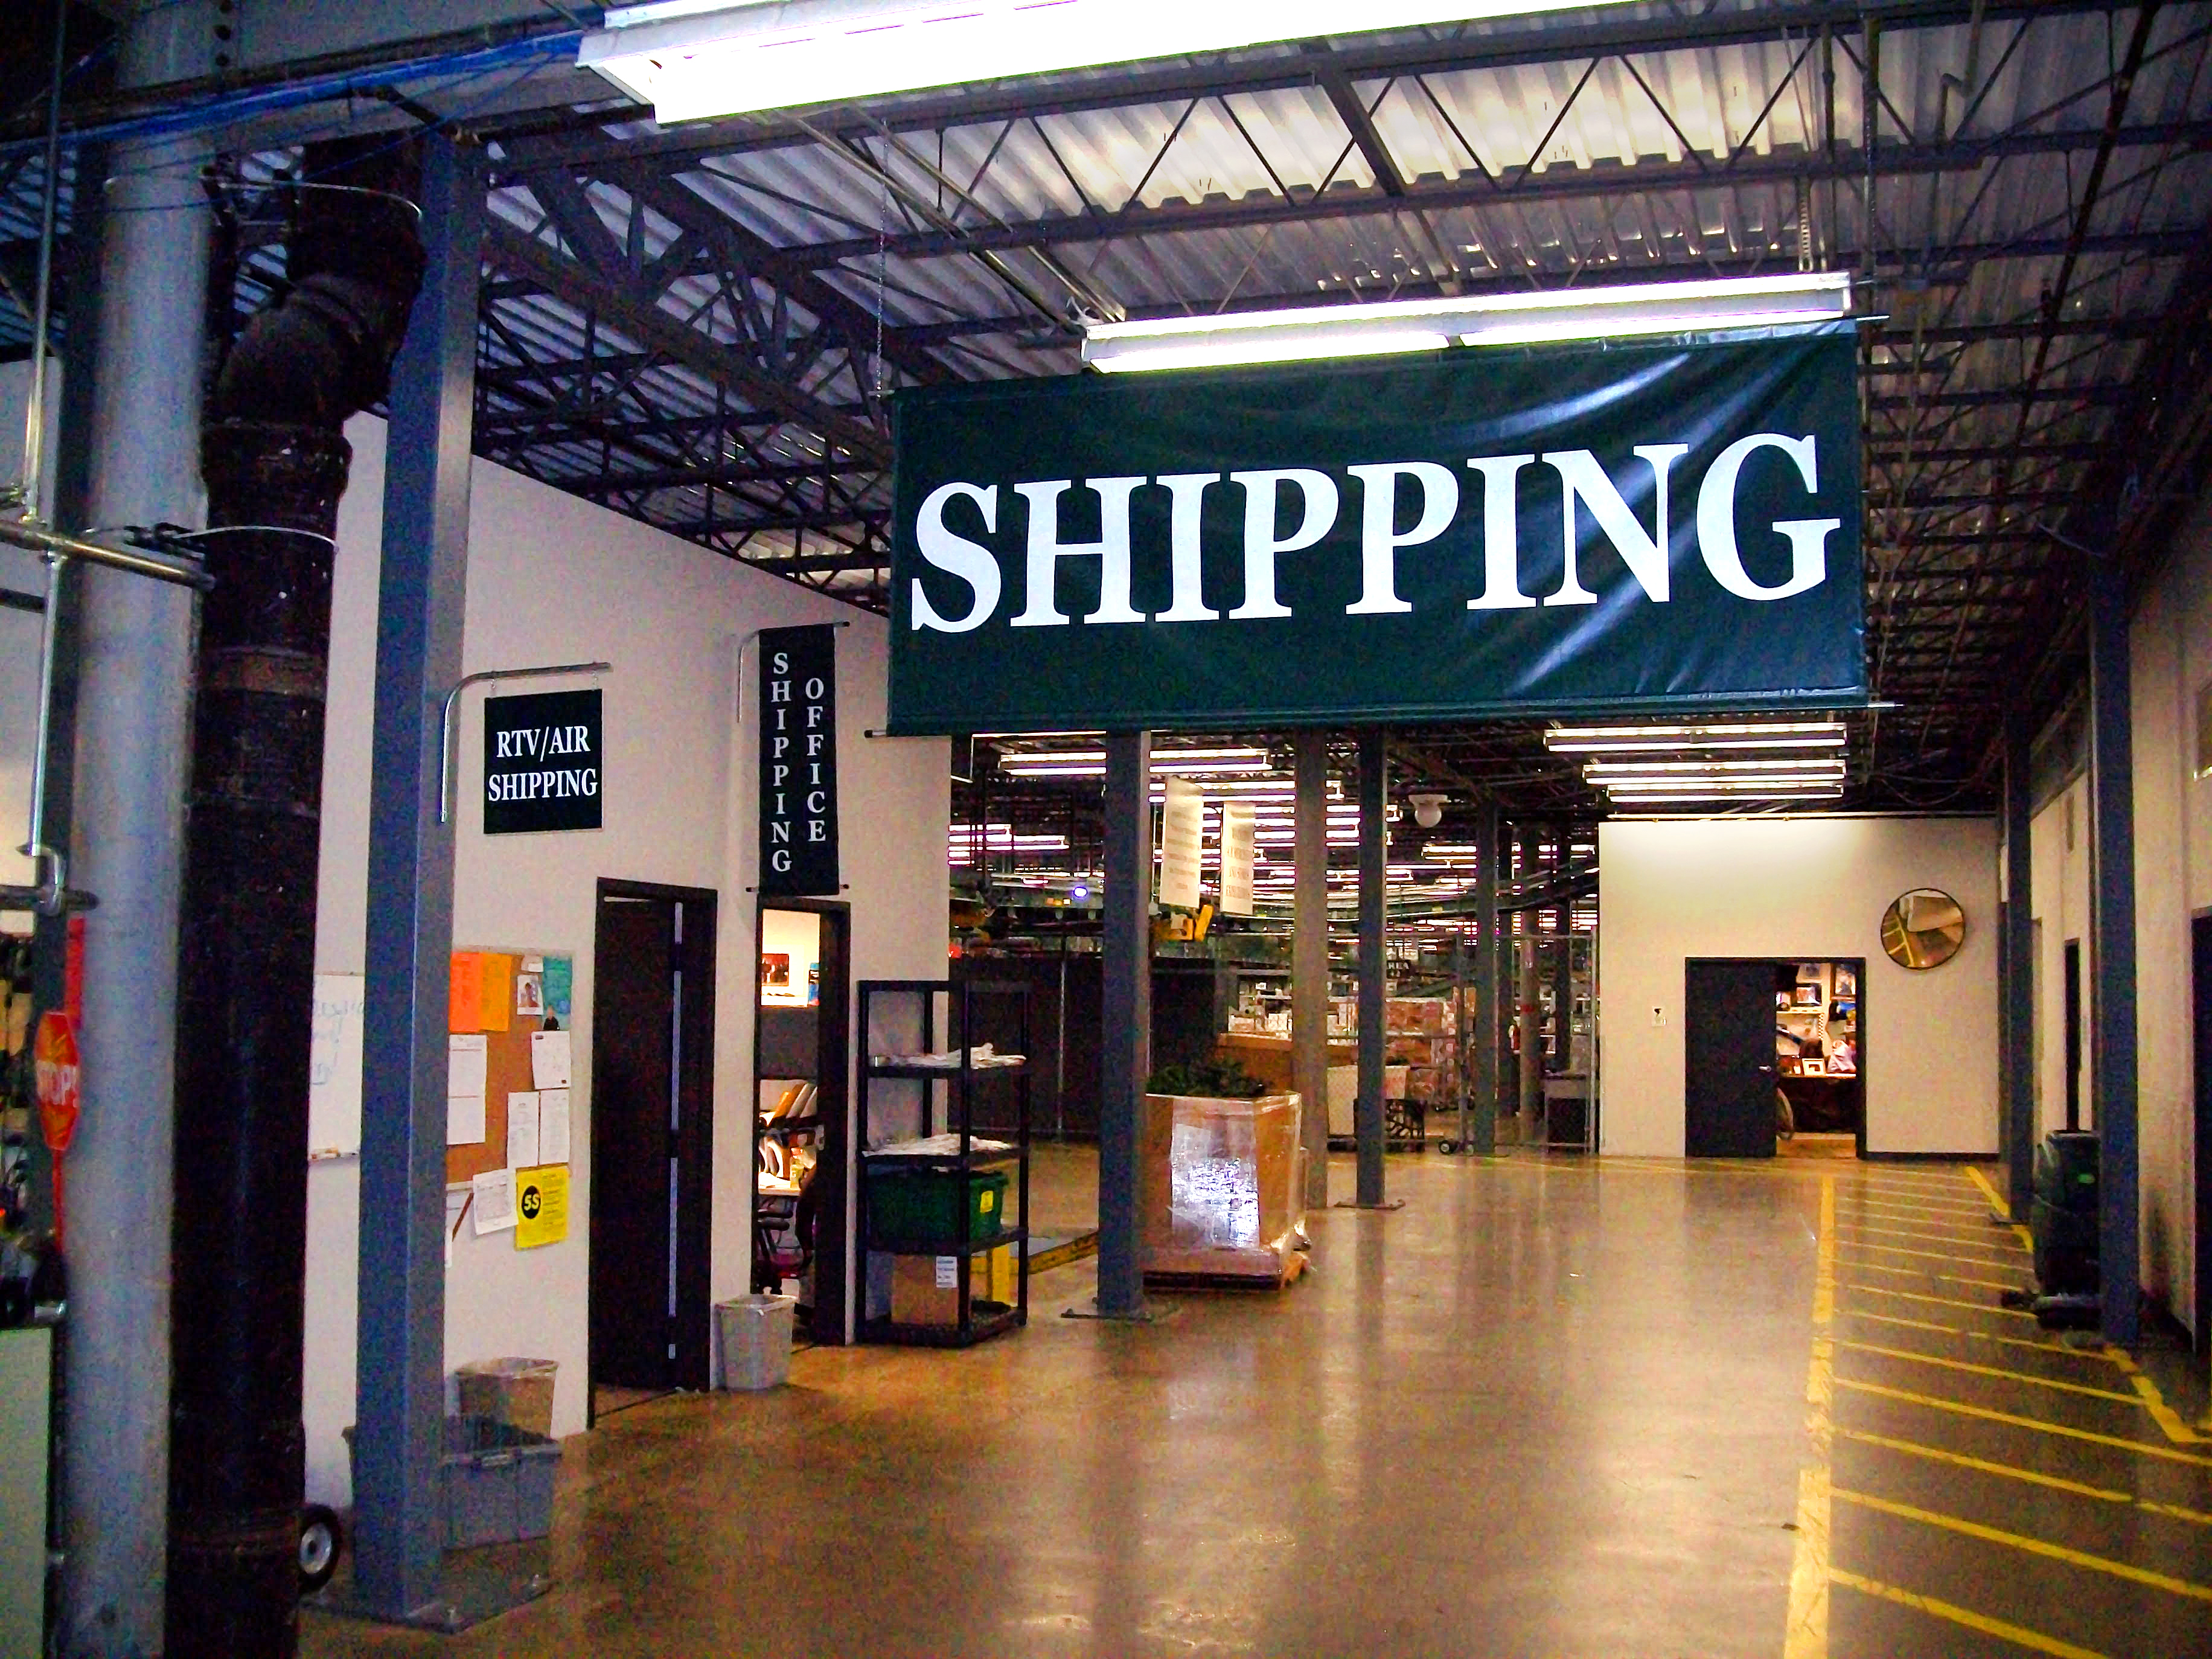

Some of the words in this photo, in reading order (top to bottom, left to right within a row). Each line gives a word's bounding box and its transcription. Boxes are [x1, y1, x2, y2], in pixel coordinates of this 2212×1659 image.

[911, 432, 1841, 634] SHIPPING
[488, 768, 598, 802] SHIPPING
[496, 726, 591, 762] RTV/AIR
[771, 652, 792, 872] SHIPPING
[805, 677, 826, 842] OFFICE
[523, 1193, 540, 1211] 5S
